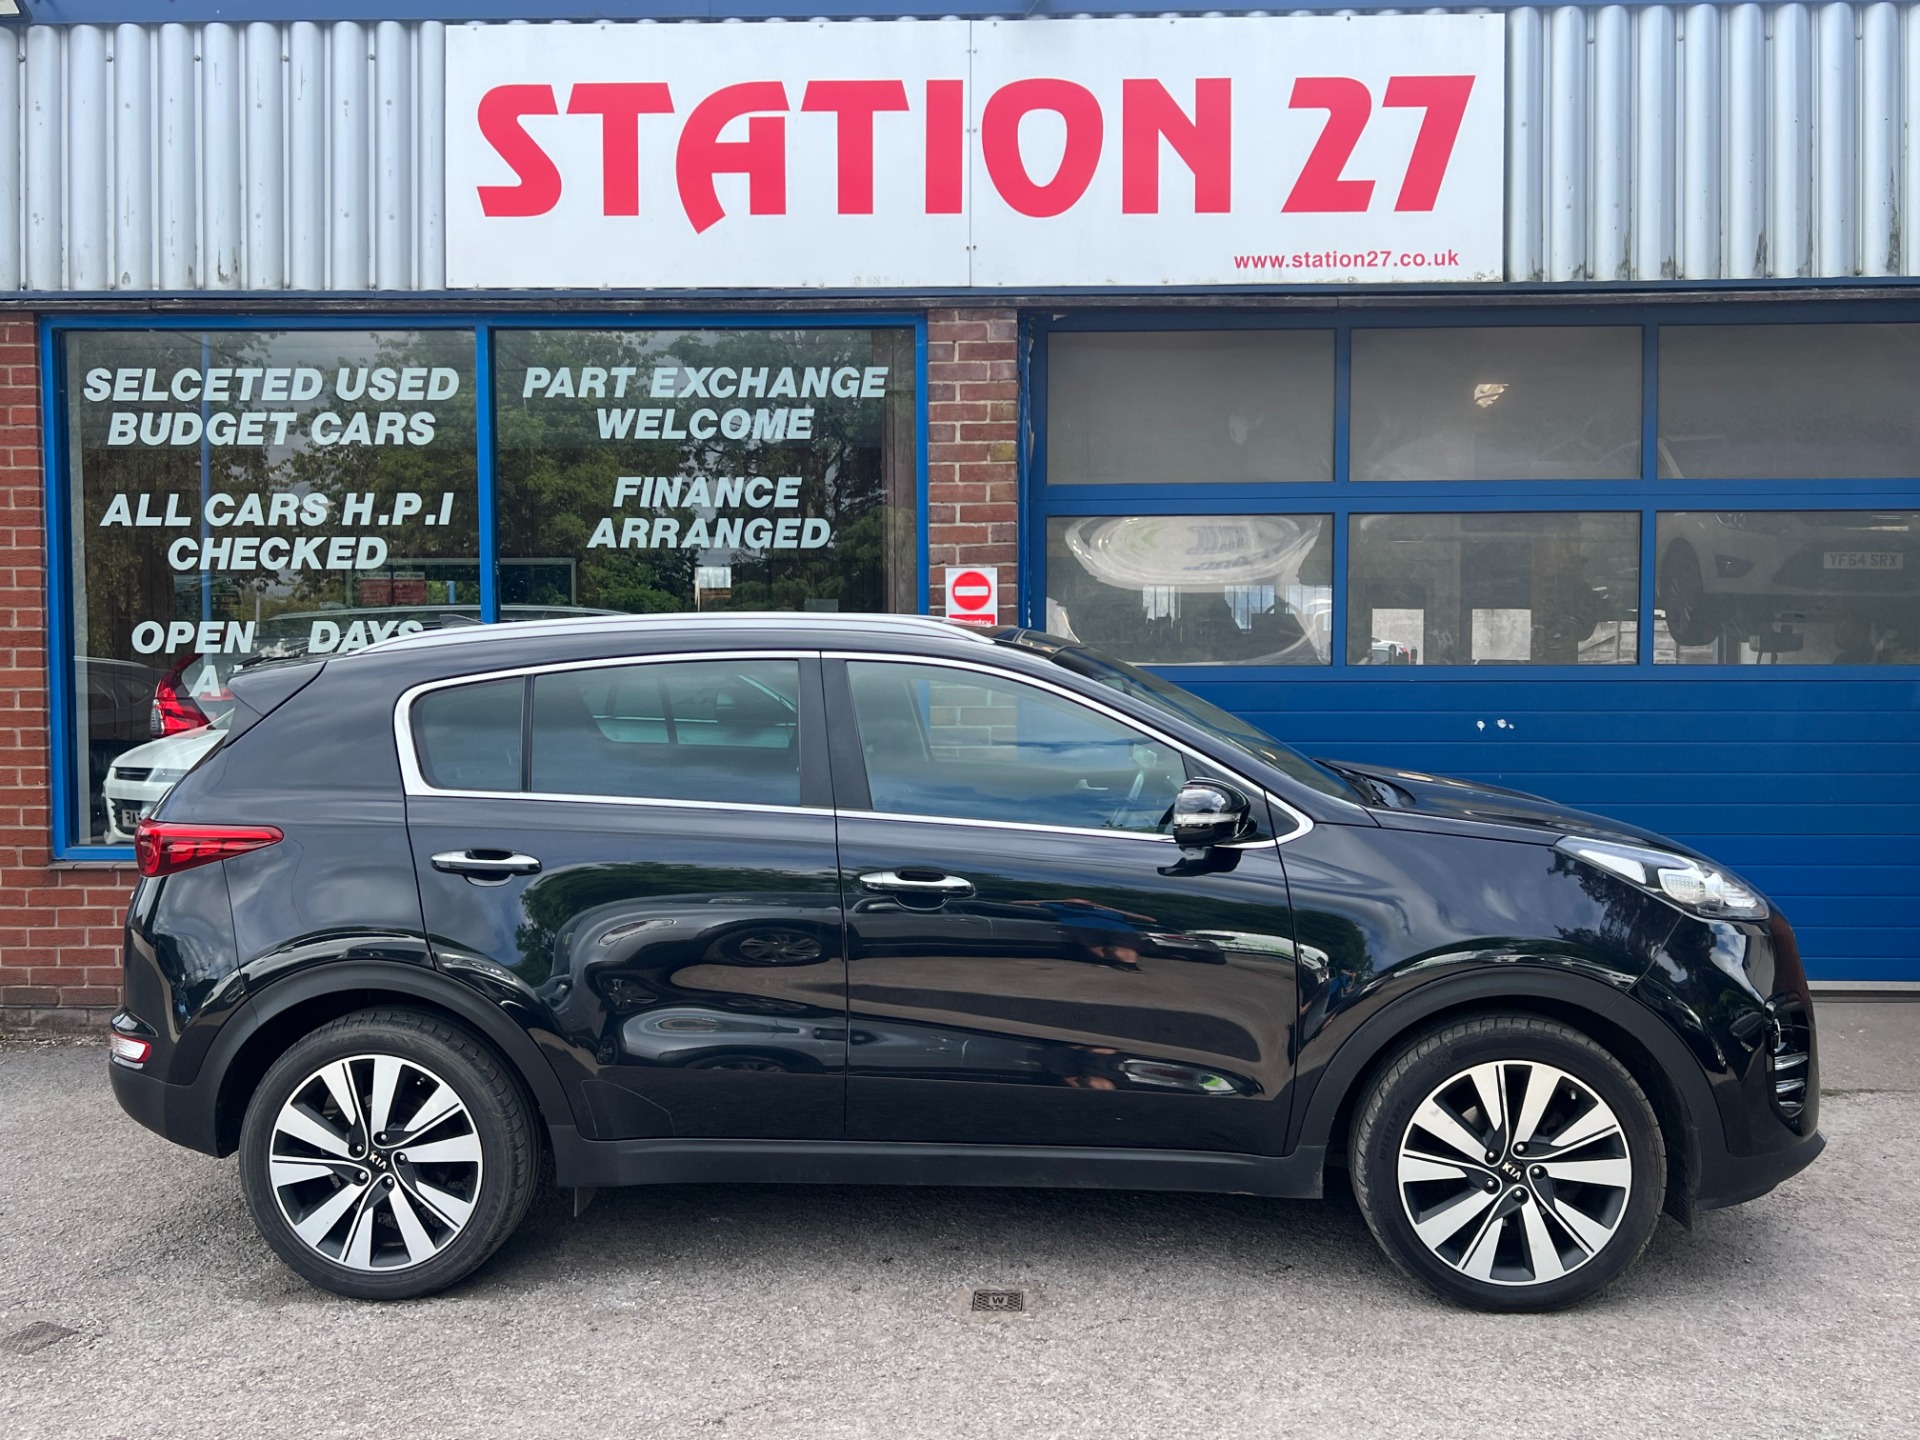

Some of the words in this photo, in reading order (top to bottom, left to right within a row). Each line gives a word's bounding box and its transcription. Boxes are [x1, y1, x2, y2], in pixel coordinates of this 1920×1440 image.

[478, 78, 1231, 233] STATION
[1282, 76, 1474, 212] 27
[1234, 250, 1459, 269] www.station27.co.uk
[84, 367, 322, 402] SELCETED
[336, 367, 460, 402] USED
[522, 366, 637, 398] PART
[649, 366, 889, 399] EXCHANGE
[107, 412, 298, 446] BUDGET
[311, 411, 436, 446] CARS
[597, 408, 815, 440] WELCOME
[613, 476, 803, 508] FINANCE
[100, 493, 192, 527] ALL
[205, 492, 329, 527] CARS
[586, 517, 831, 550] ARRANGED
[168, 536, 389, 571] CHECKED
[1870, 554, 1897, 567] SRX
[131, 620, 256, 654] OPEN
[189, 664, 222, 698] A
[369, 1152, 388, 1170] KIA
[1502, 1161, 1522, 1181] KIA
[992, 1296, 1005, 1304] W
